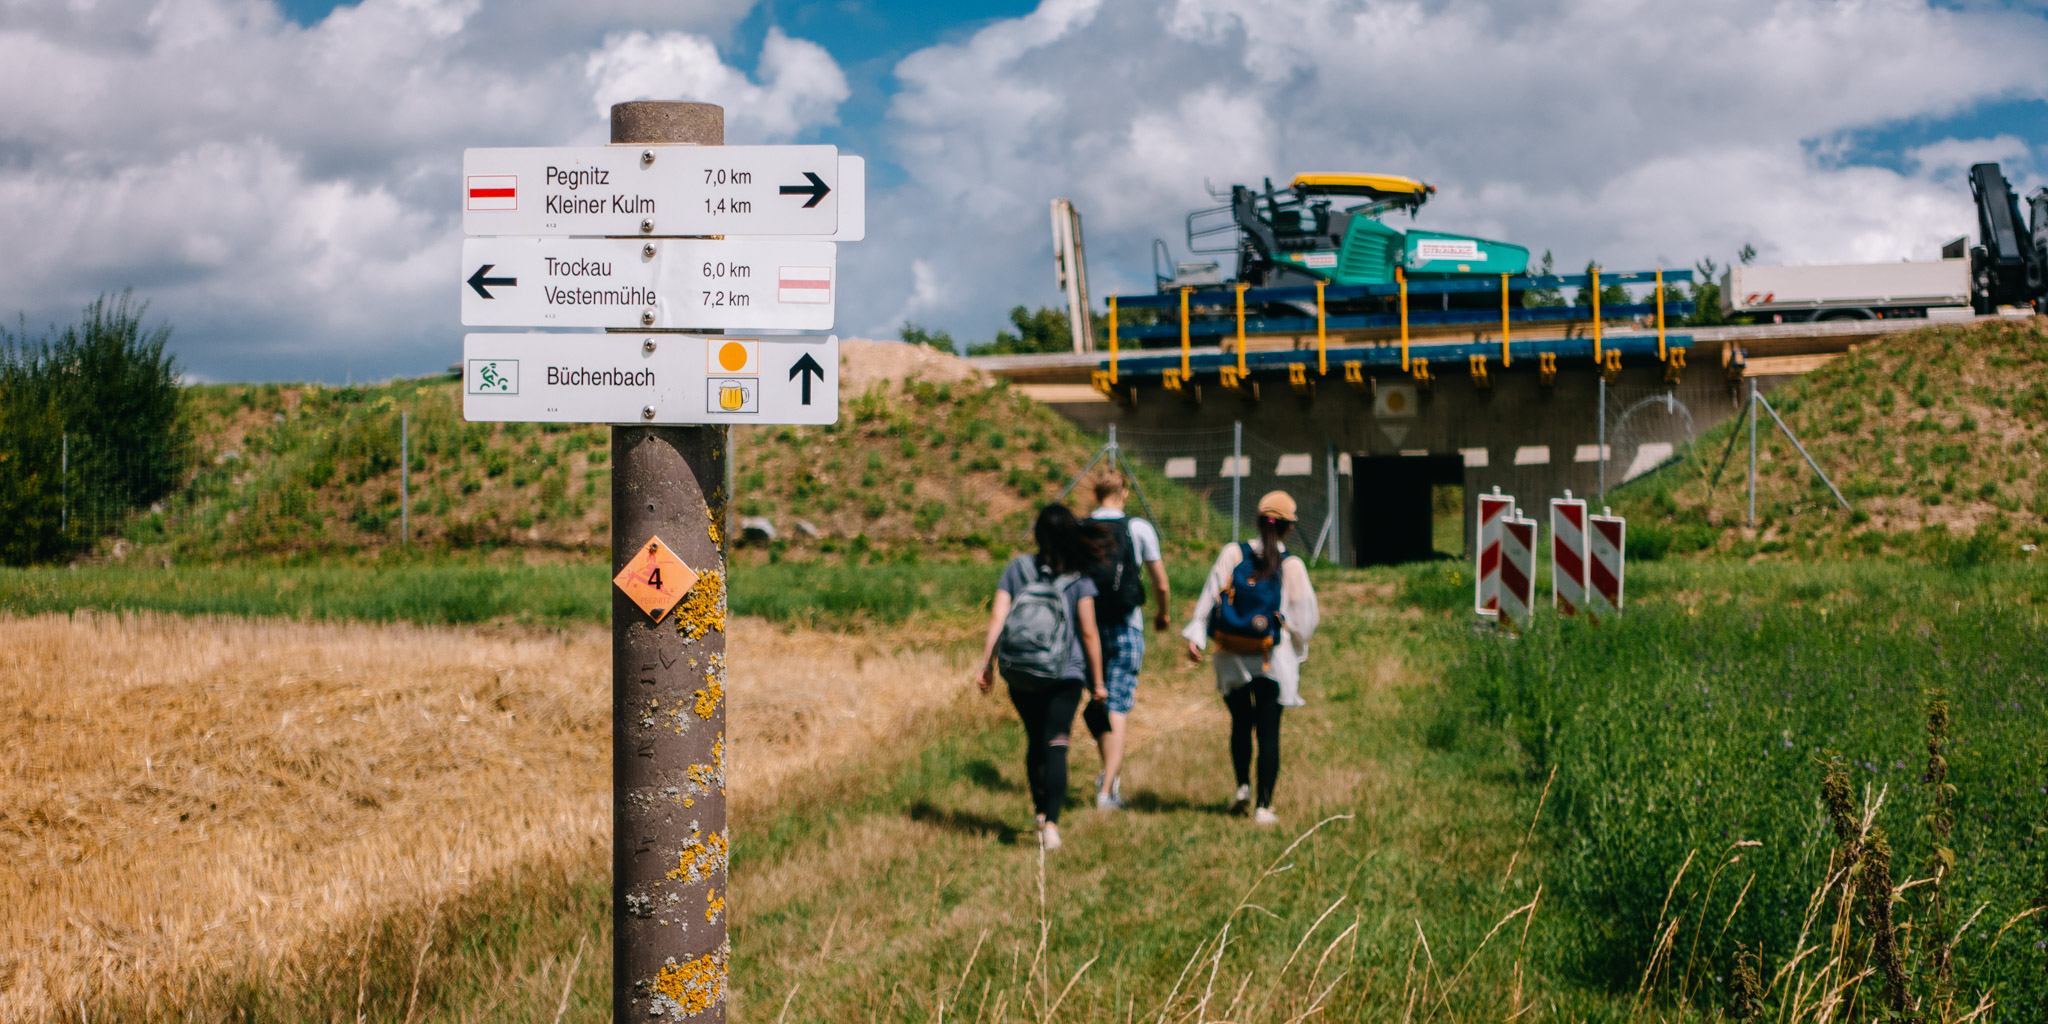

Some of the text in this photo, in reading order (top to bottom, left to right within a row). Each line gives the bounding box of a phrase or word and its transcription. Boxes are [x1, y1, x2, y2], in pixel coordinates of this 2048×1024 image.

[546, 166, 610, 190] Pegnitz
[704, 169, 752, 187] 7,0 km
[546, 194, 655, 214] Kleiner Kulm
[704, 198, 752, 216] 1,4 km
[544, 257, 612, 276] Trockau
[702, 262, 751, 280] 6,0 km
[544, 285, 656, 306] Vestenmühle
[702, 291, 750, 309] 7,2 km
[547, 366, 655, 387] Büchenbach
[647, 567, 663, 590] 4
[640, 597, 672, 605] PEGNITZ
